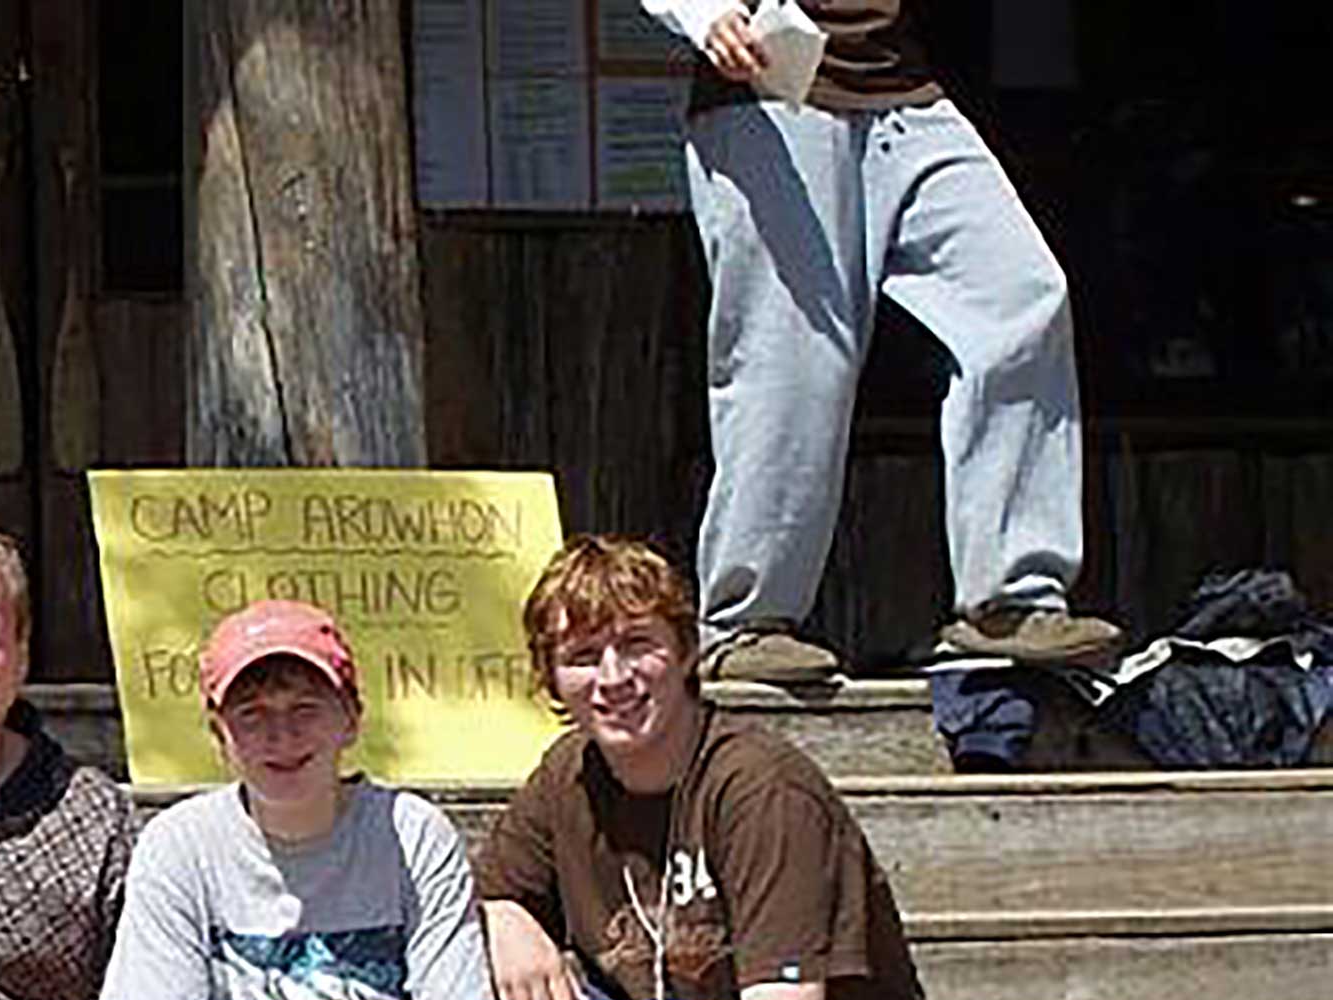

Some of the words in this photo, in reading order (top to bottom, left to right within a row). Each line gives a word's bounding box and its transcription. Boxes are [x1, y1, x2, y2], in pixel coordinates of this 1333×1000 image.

[131, 492, 272, 541] CAMP
[303, 493, 523, 547] AROWHON
[203, 568, 462, 615] CLOTHING
[386, 654, 435, 700] IN
